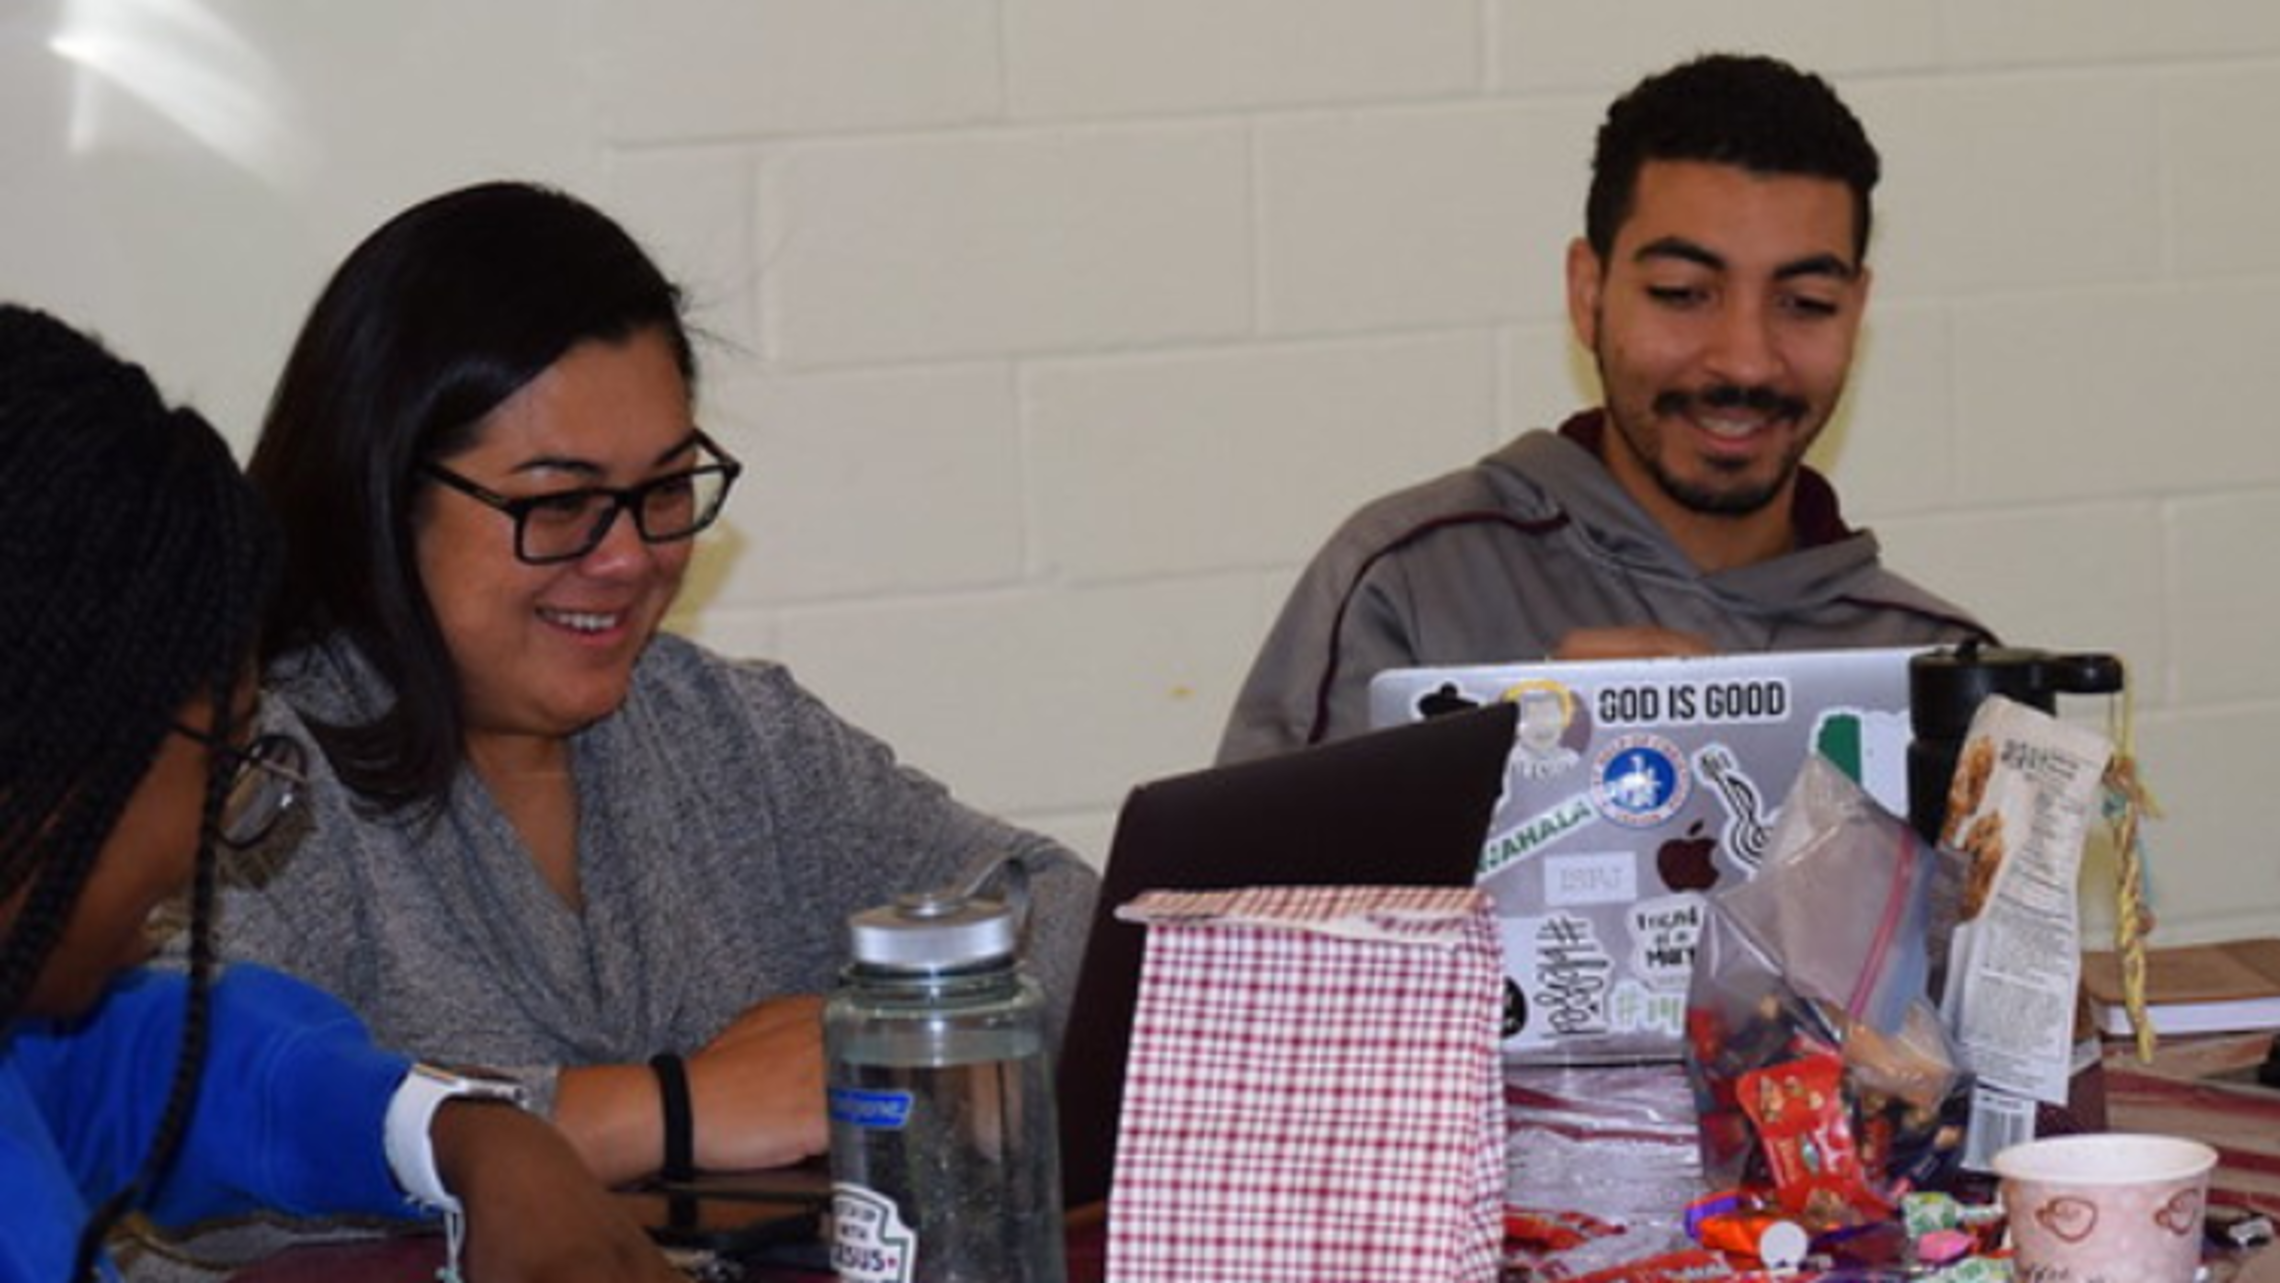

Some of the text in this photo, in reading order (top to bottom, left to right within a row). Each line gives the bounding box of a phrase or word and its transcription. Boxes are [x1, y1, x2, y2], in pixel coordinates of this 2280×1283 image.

[1600, 681, 1787, 723] GOD IS GOOD
